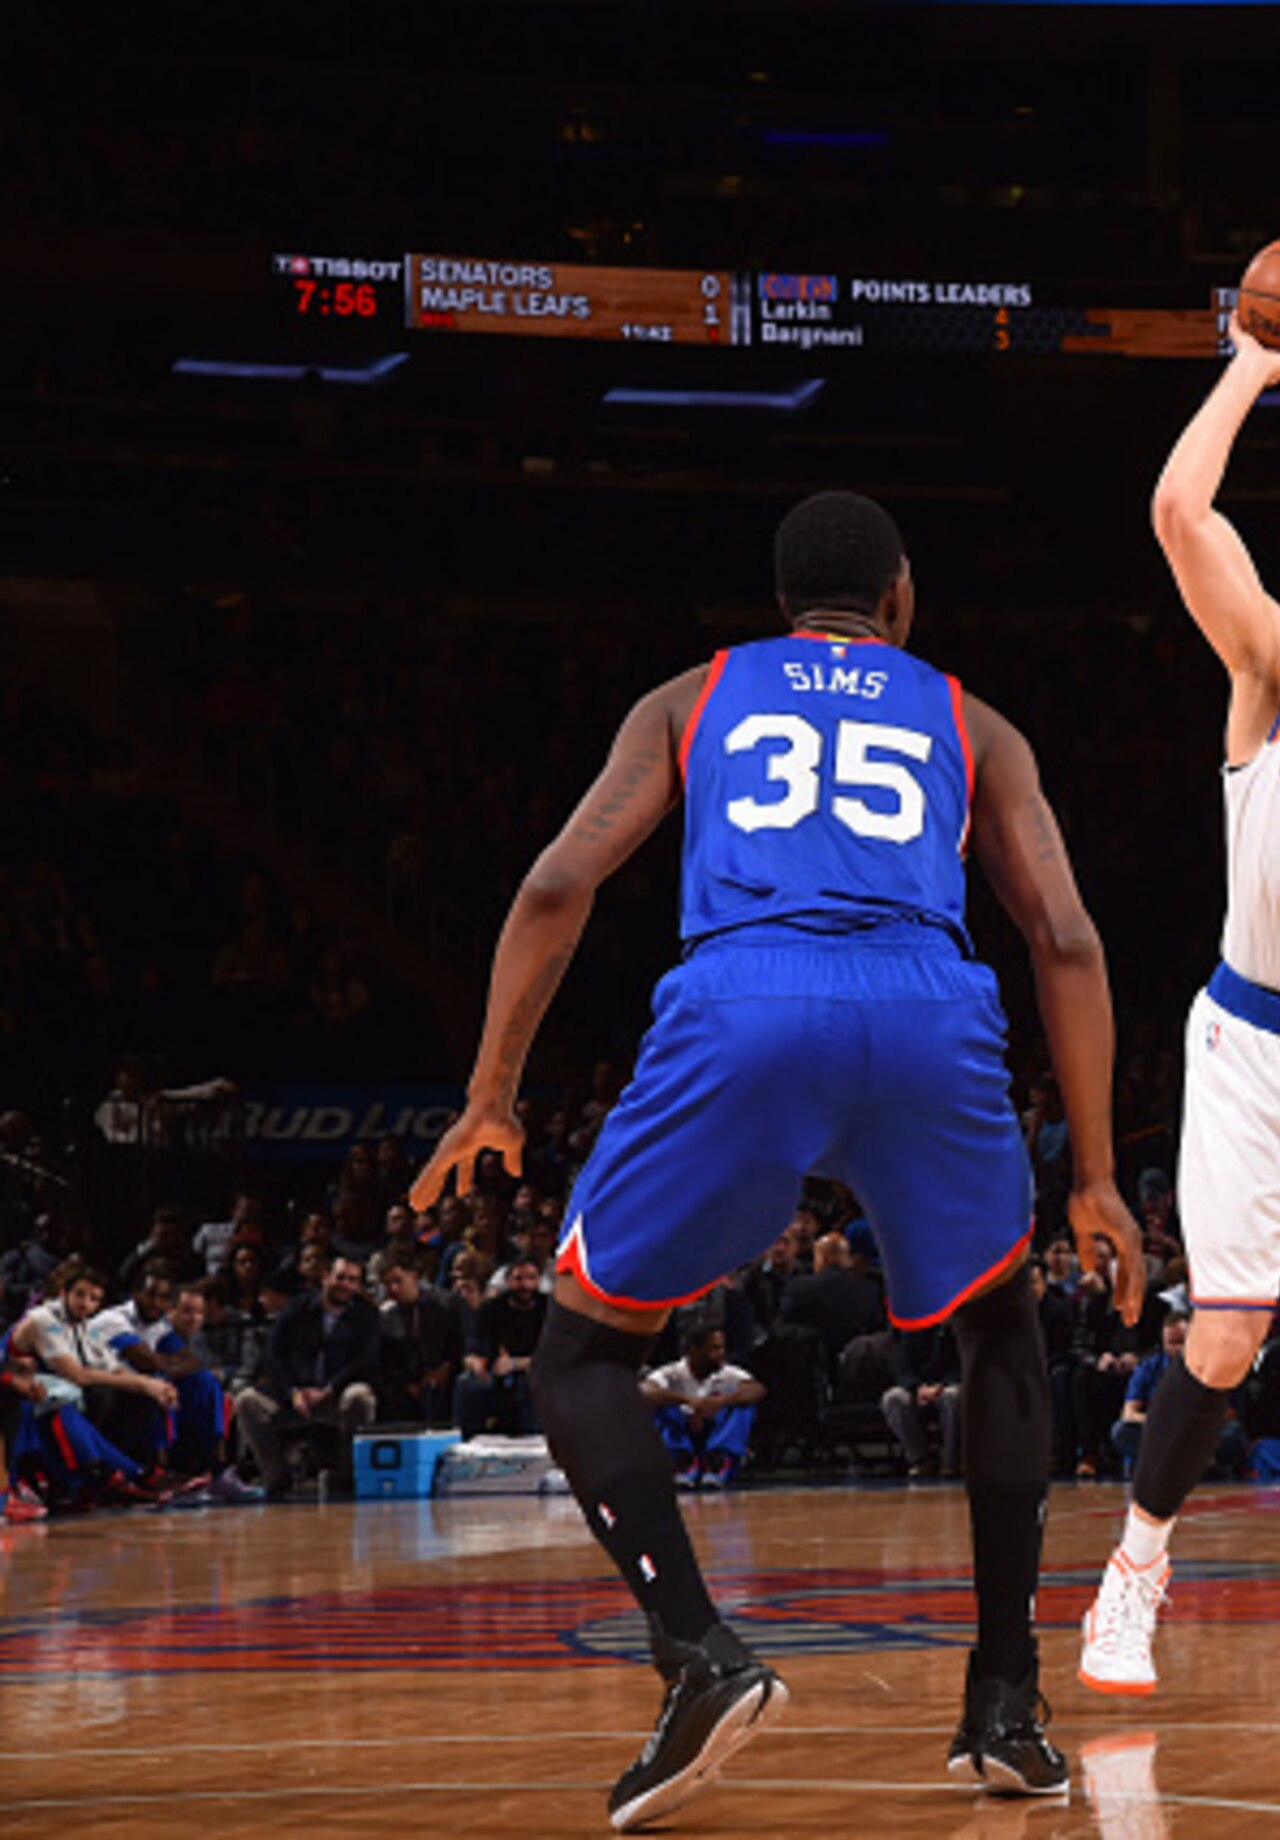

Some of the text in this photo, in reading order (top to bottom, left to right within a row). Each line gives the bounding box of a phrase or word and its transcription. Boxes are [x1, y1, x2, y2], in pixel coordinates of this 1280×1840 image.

[309, 257, 401, 282] TISSOT
[420, 260, 719, 297] SENATORS 0
[294, 280, 378, 317] 7:56
[420, 285, 719, 325] MAPLE LEAFS 1
[760, 300, 832, 321] Larkin
[852, 279, 930, 302] POINTS
[934, 283, 1032, 307] LEADERS
[783, 662, 889, 700] SIMS
[724, 713, 933, 845] 35
[356, 1102, 453, 1140] LIG
